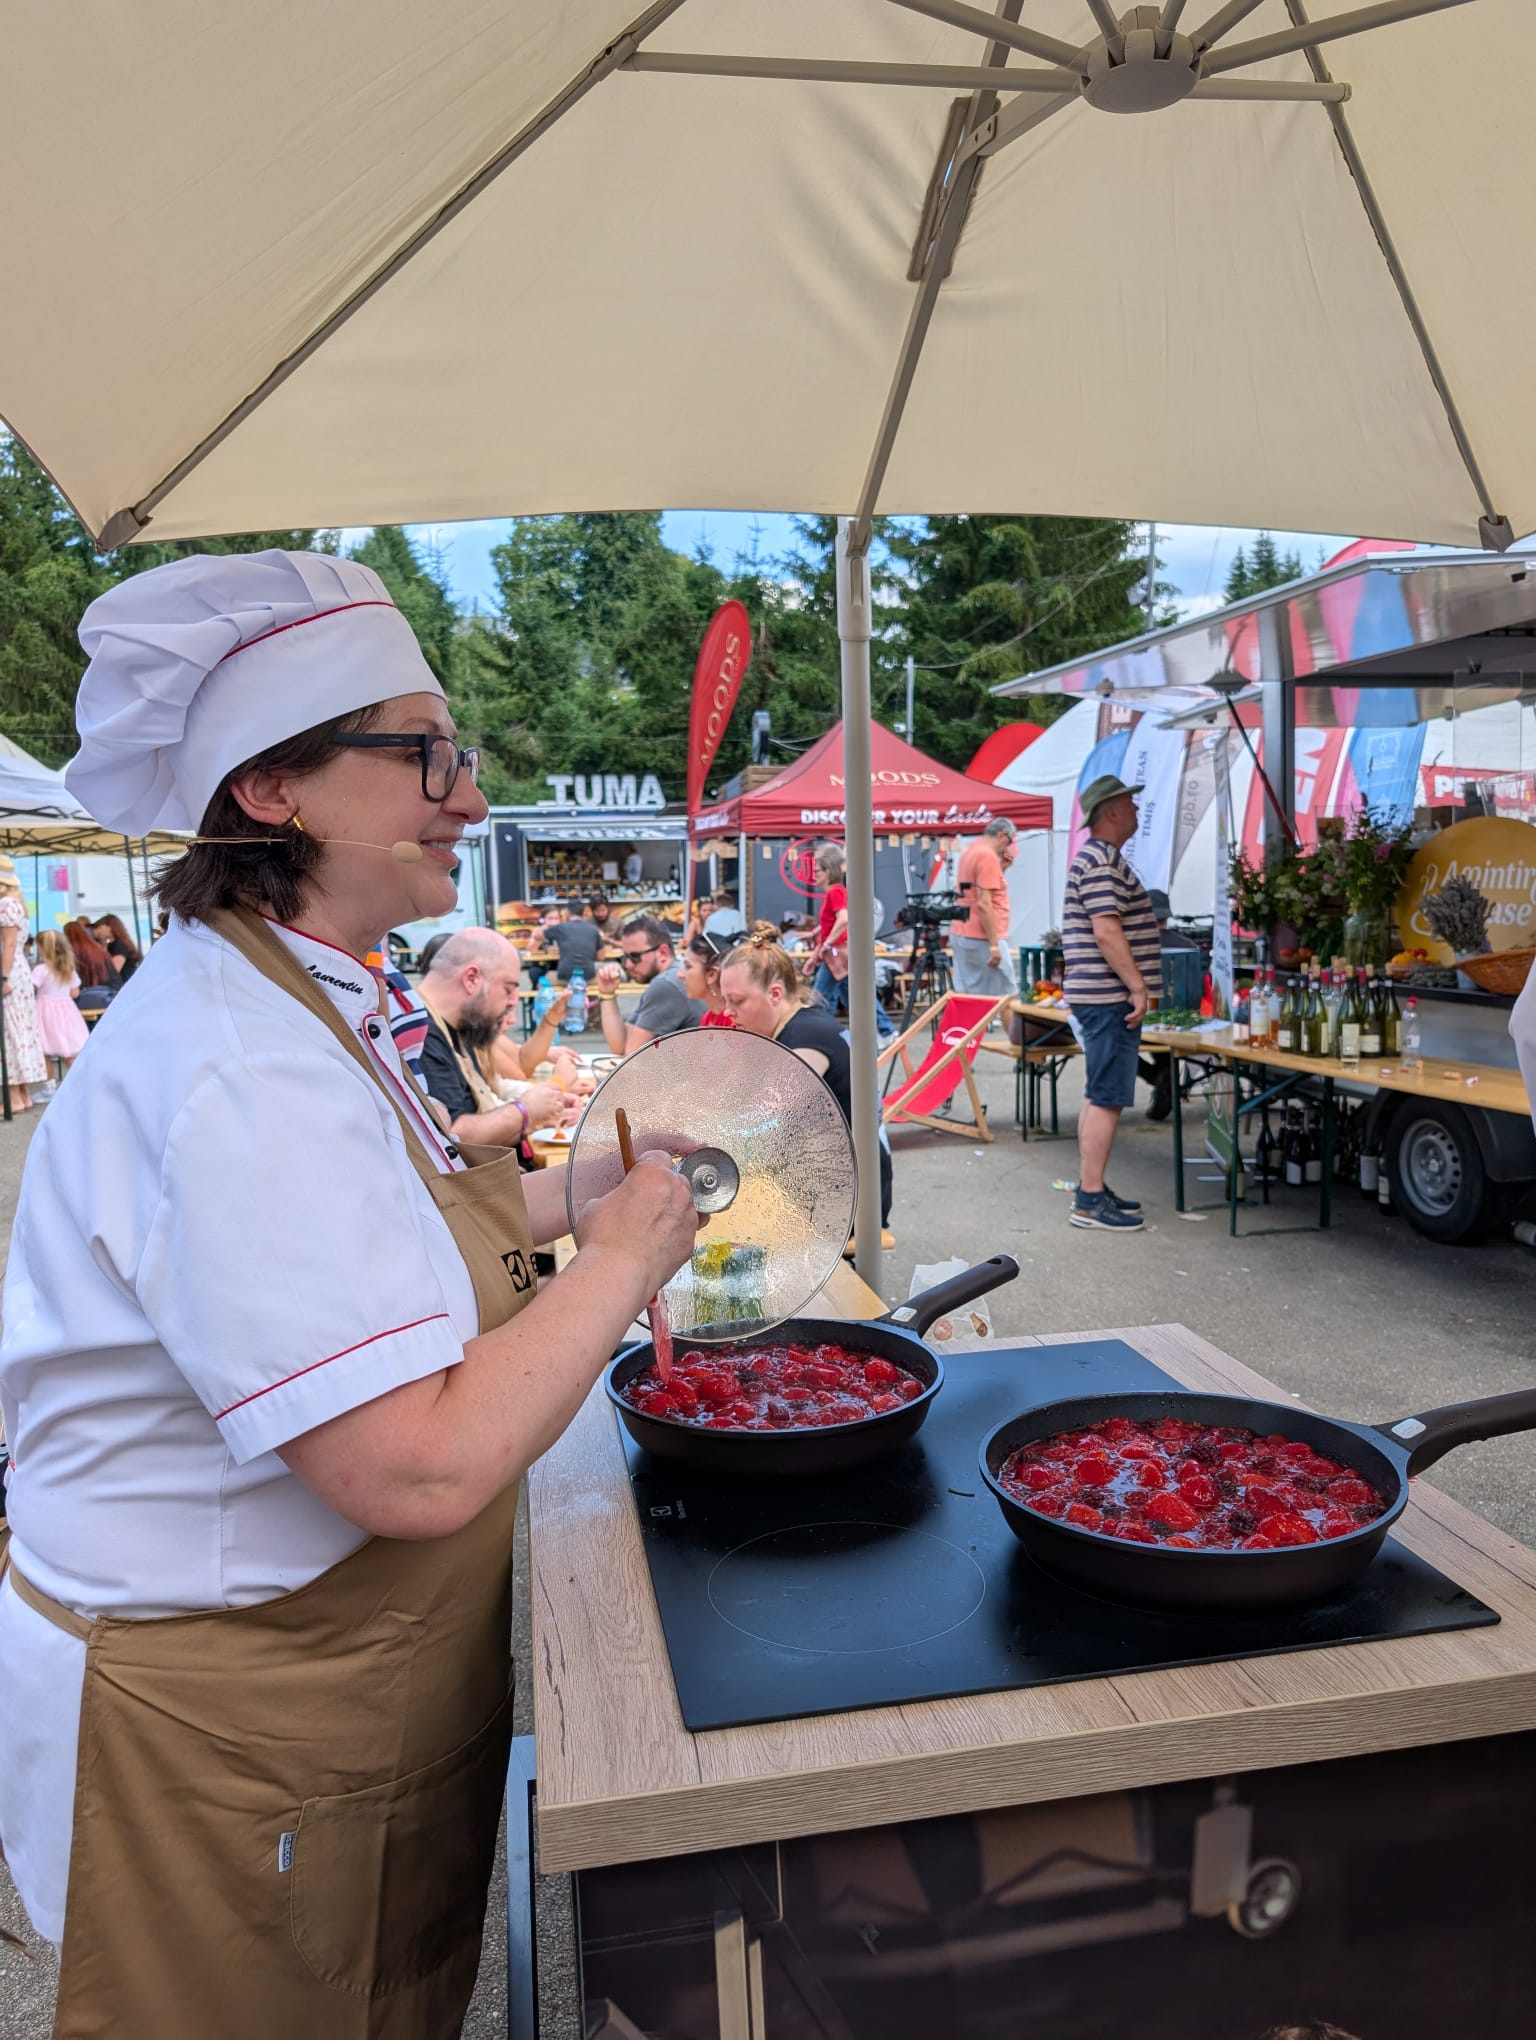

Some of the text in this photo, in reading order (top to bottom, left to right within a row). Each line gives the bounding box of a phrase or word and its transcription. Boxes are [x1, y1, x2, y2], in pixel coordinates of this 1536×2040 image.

[539, 773, 668, 810] TUMA
[829, 769, 941, 787] MODS
[890, 808, 940, 825] YOUR
[943, 802, 994, 825] taste
[1427, 859, 1536, 892] Amintir
